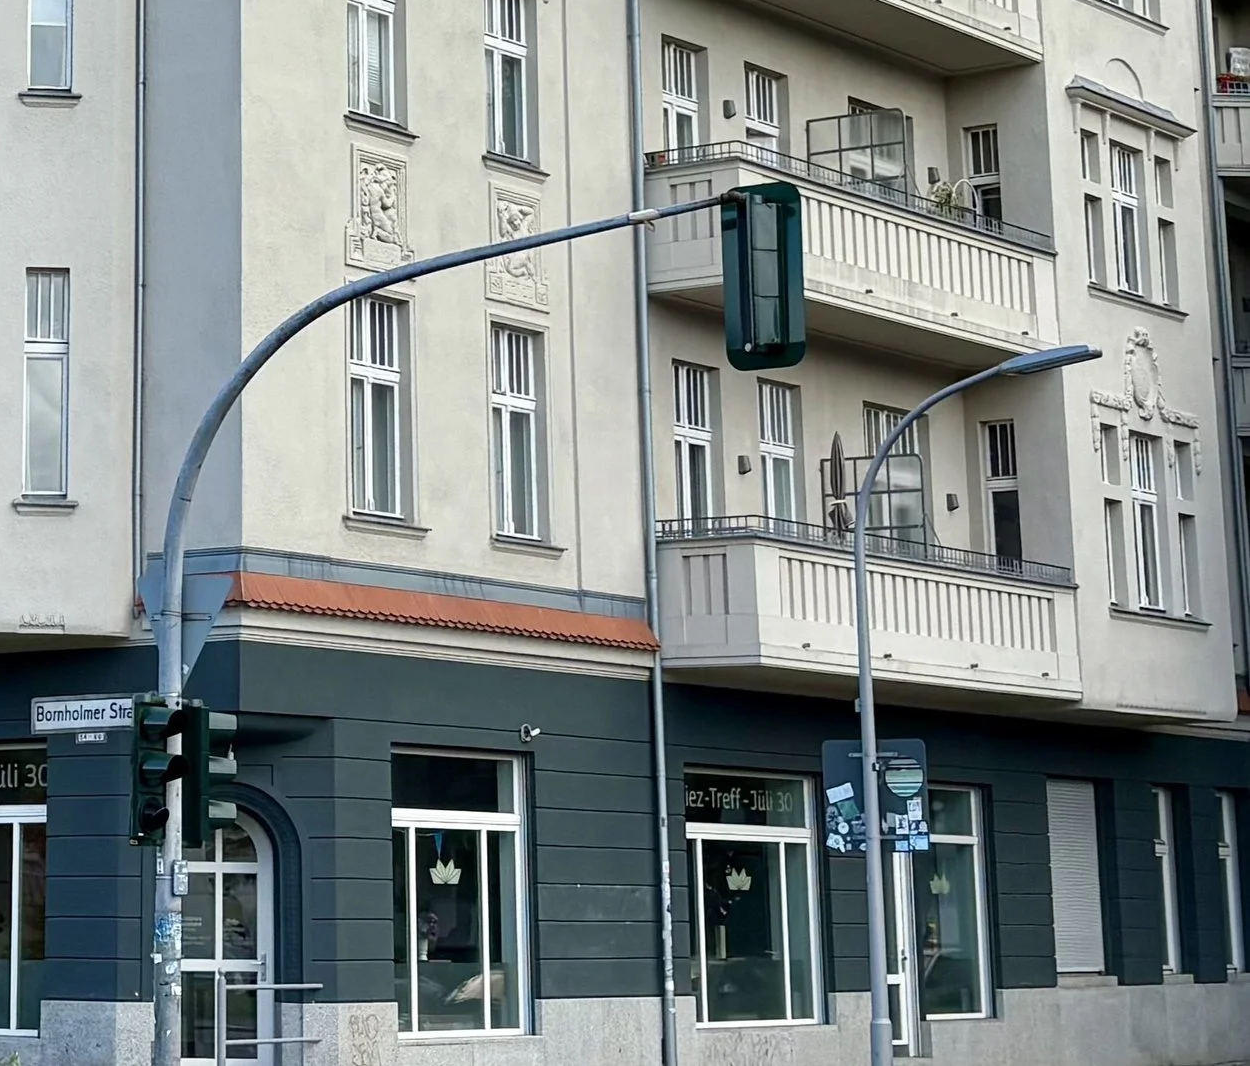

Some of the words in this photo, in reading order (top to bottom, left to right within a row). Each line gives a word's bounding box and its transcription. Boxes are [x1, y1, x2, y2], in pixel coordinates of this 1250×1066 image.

[36, 703, 106, 722] Bornholmer
[110, 701, 133, 719] Stra
[685, 785, 741, 810] iez-Treff
